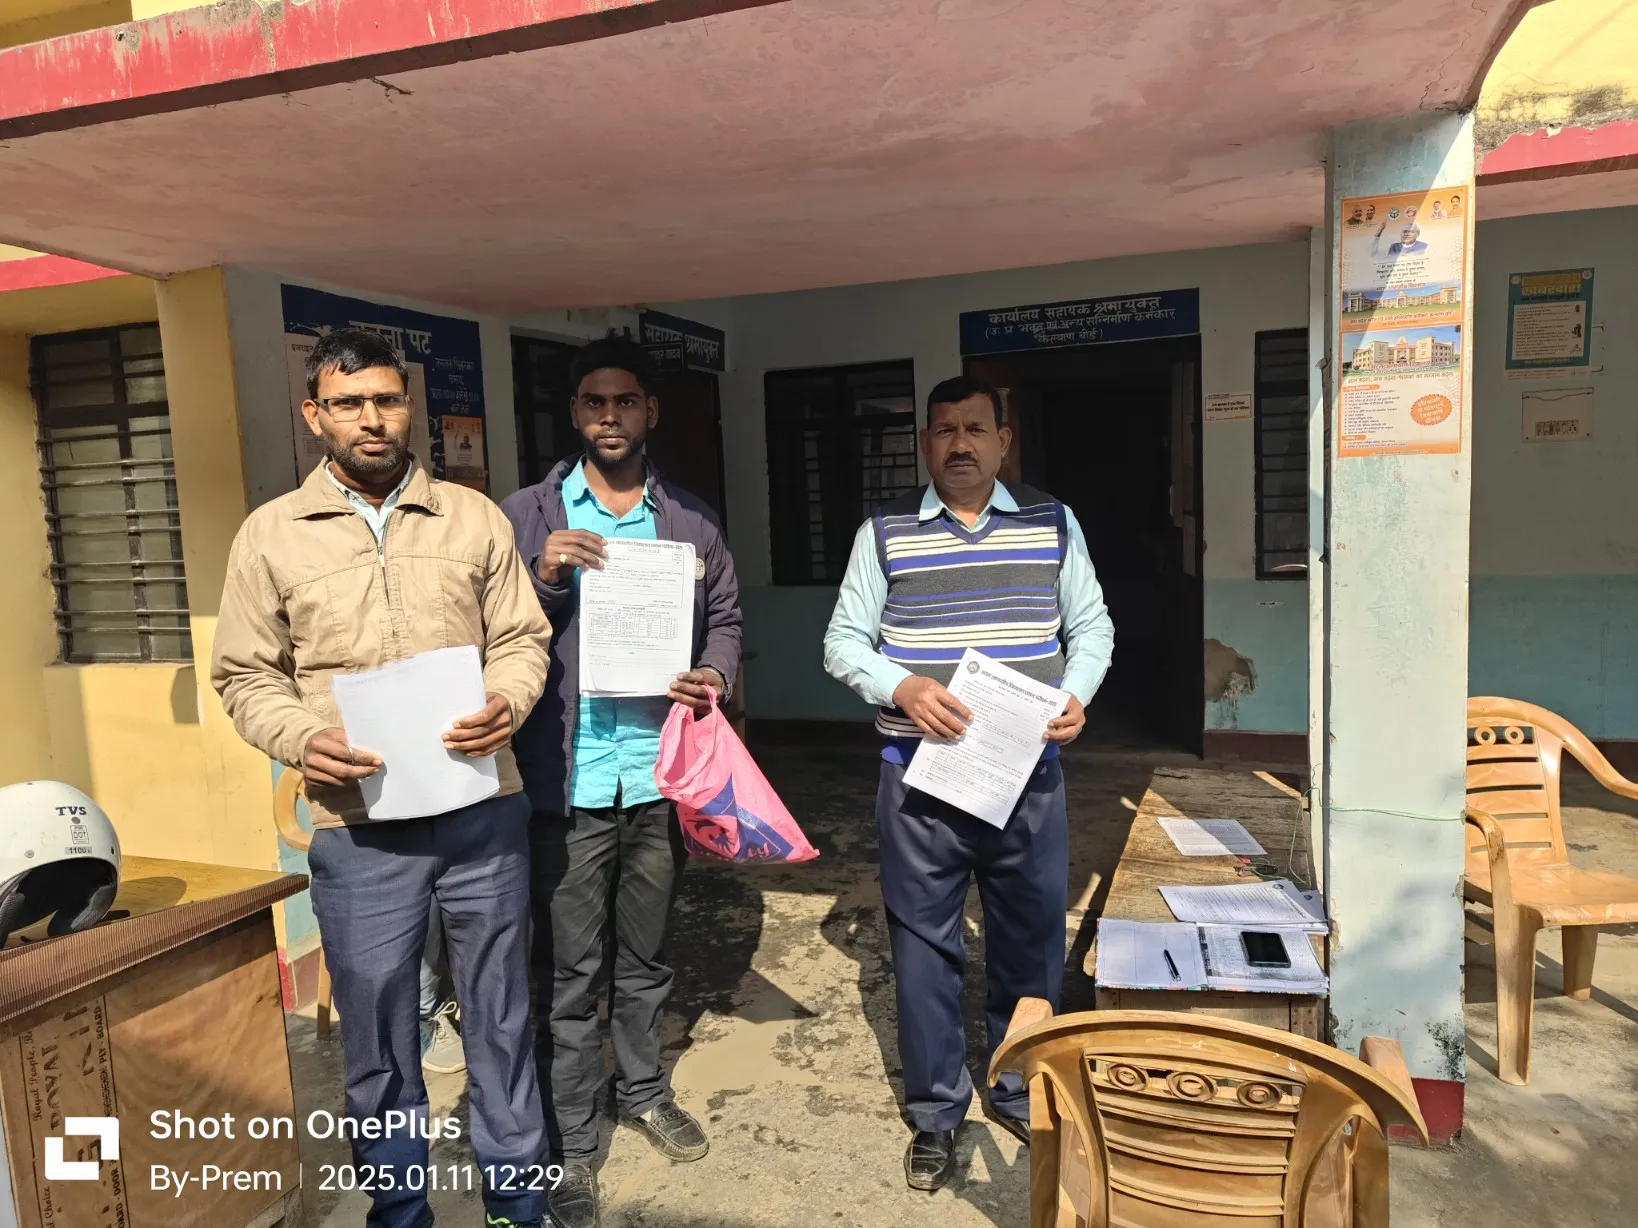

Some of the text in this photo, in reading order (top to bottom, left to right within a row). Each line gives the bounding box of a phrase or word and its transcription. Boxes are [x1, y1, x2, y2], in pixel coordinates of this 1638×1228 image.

[988, 306, 1039, 324] कार्यालय
[1045, 303, 1091, 320] सहायक
[406, 328, 432, 355] पट
[56, 806, 87, 816] TVS
[94, 1006, 104, 1039] BOARD
[32, 1087, 43, 1121] Royal
[41, 1186, 54, 1218] Choice
